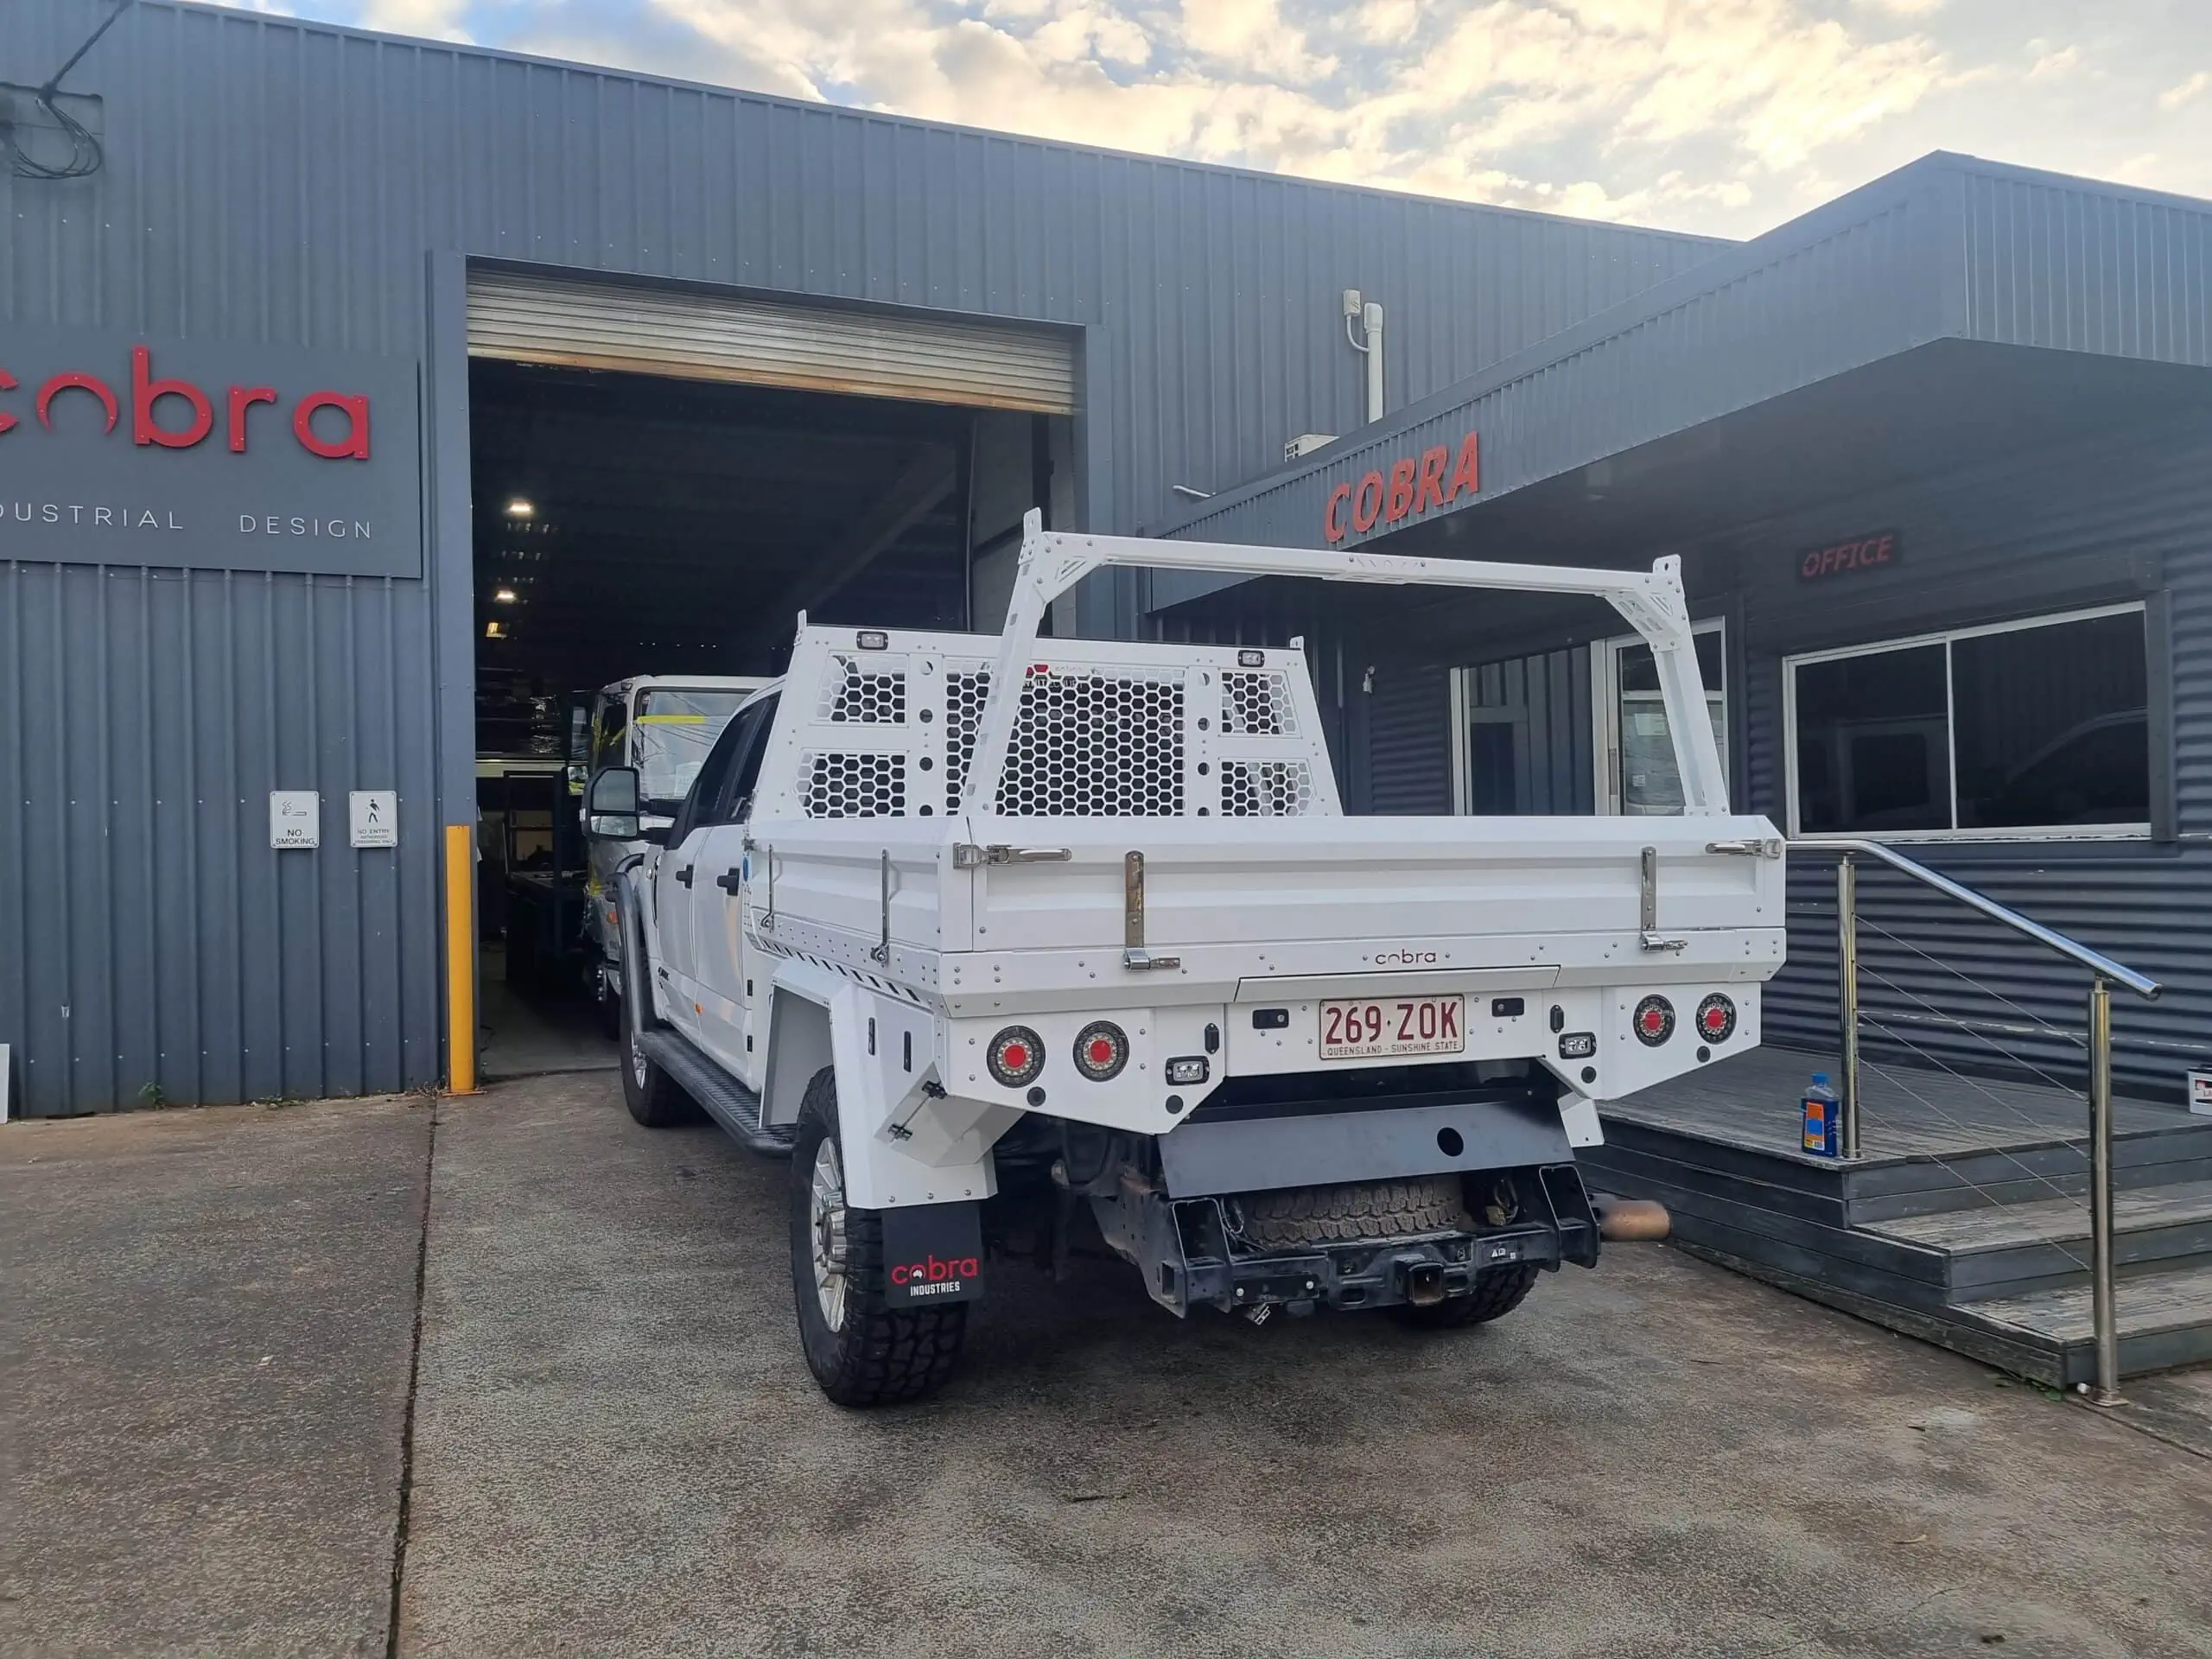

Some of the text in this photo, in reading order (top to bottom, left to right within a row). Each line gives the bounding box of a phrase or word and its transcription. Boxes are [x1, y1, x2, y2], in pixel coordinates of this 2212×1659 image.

[0, 346, 369, 459] obra
[1325, 429, 1479, 543] COBRA
[0, 501, 373, 539] USTRIAL DESIGN
[1802, 534, 1893, 576] OFFICE
[1375, 949, 1436, 965] cobra
[1327, 1045, 1382, 1056] QUEENSLAND
[1391, 1042, 1431, 1053] SUNSHINE
[1434, 1040, 1459, 1051] STATE
[891, 1255, 980, 1285] cobra
[910, 1281, 961, 1297] INDUSTRIES
